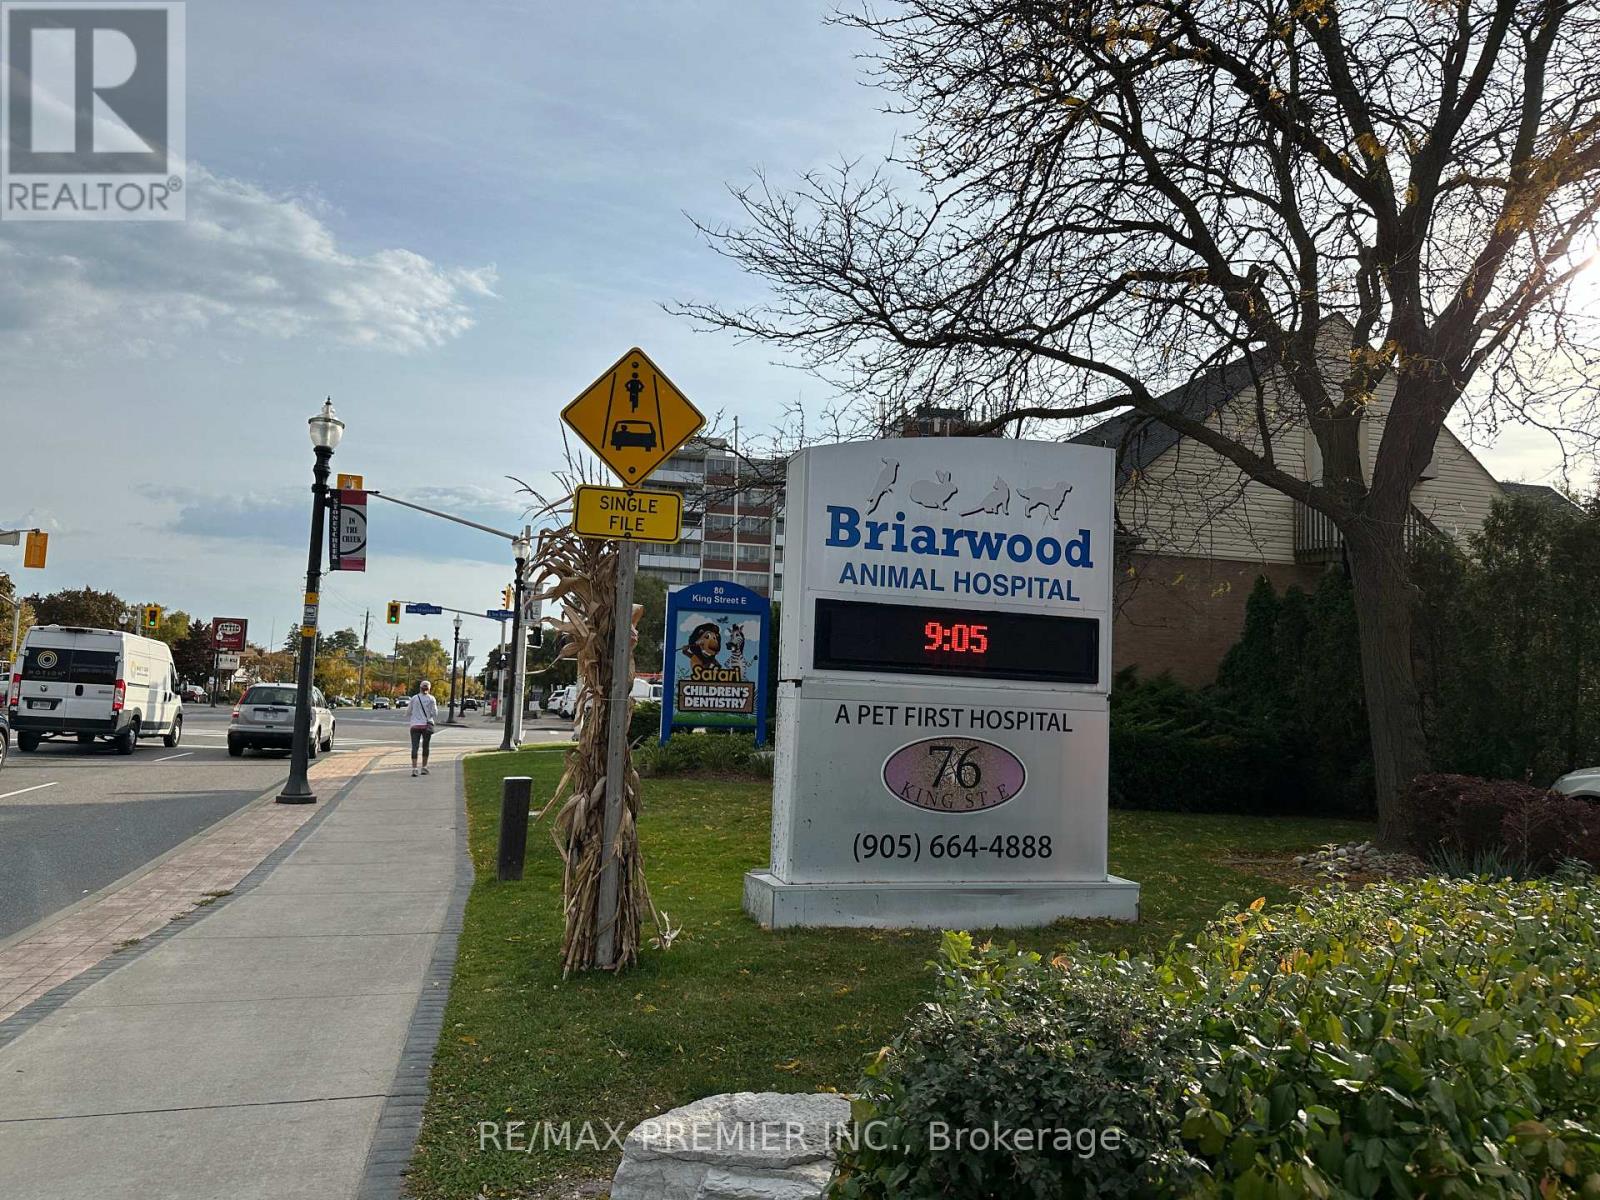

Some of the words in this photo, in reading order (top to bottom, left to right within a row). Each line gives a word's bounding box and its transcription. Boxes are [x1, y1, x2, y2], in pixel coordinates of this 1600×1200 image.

[600, 495, 658, 513] SINGLE
[609, 515, 645, 532] FILE
[825, 505, 1094, 568] Briarwood
[713, 586, 724, 595] 80
[839, 562, 945, 592] ANIMAL
[953, 570, 1081, 602] HOSPITAL
[692, 594, 713, 605] King
[714, 595, 740, 605] Street
[741, 596, 747, 605] E
[924, 622, 988, 654] 9:05
[692, 666, 740, 682] Safari
[683, 685, 750, 698] CHILDREN'S
[684, 697, 748, 709] DENTISTRY
[834, 704, 851, 725] A
[857, 705, 899, 726] PET
[904, 707, 965, 728] FIRST
[970, 709, 1073, 733] HOSPITAL
[928, 745, 982, 789] 76
[900, 781, 953, 809] KING
[853, 832, 922, 863] (905)
[929, 834, 1053, 859] 664-4888
